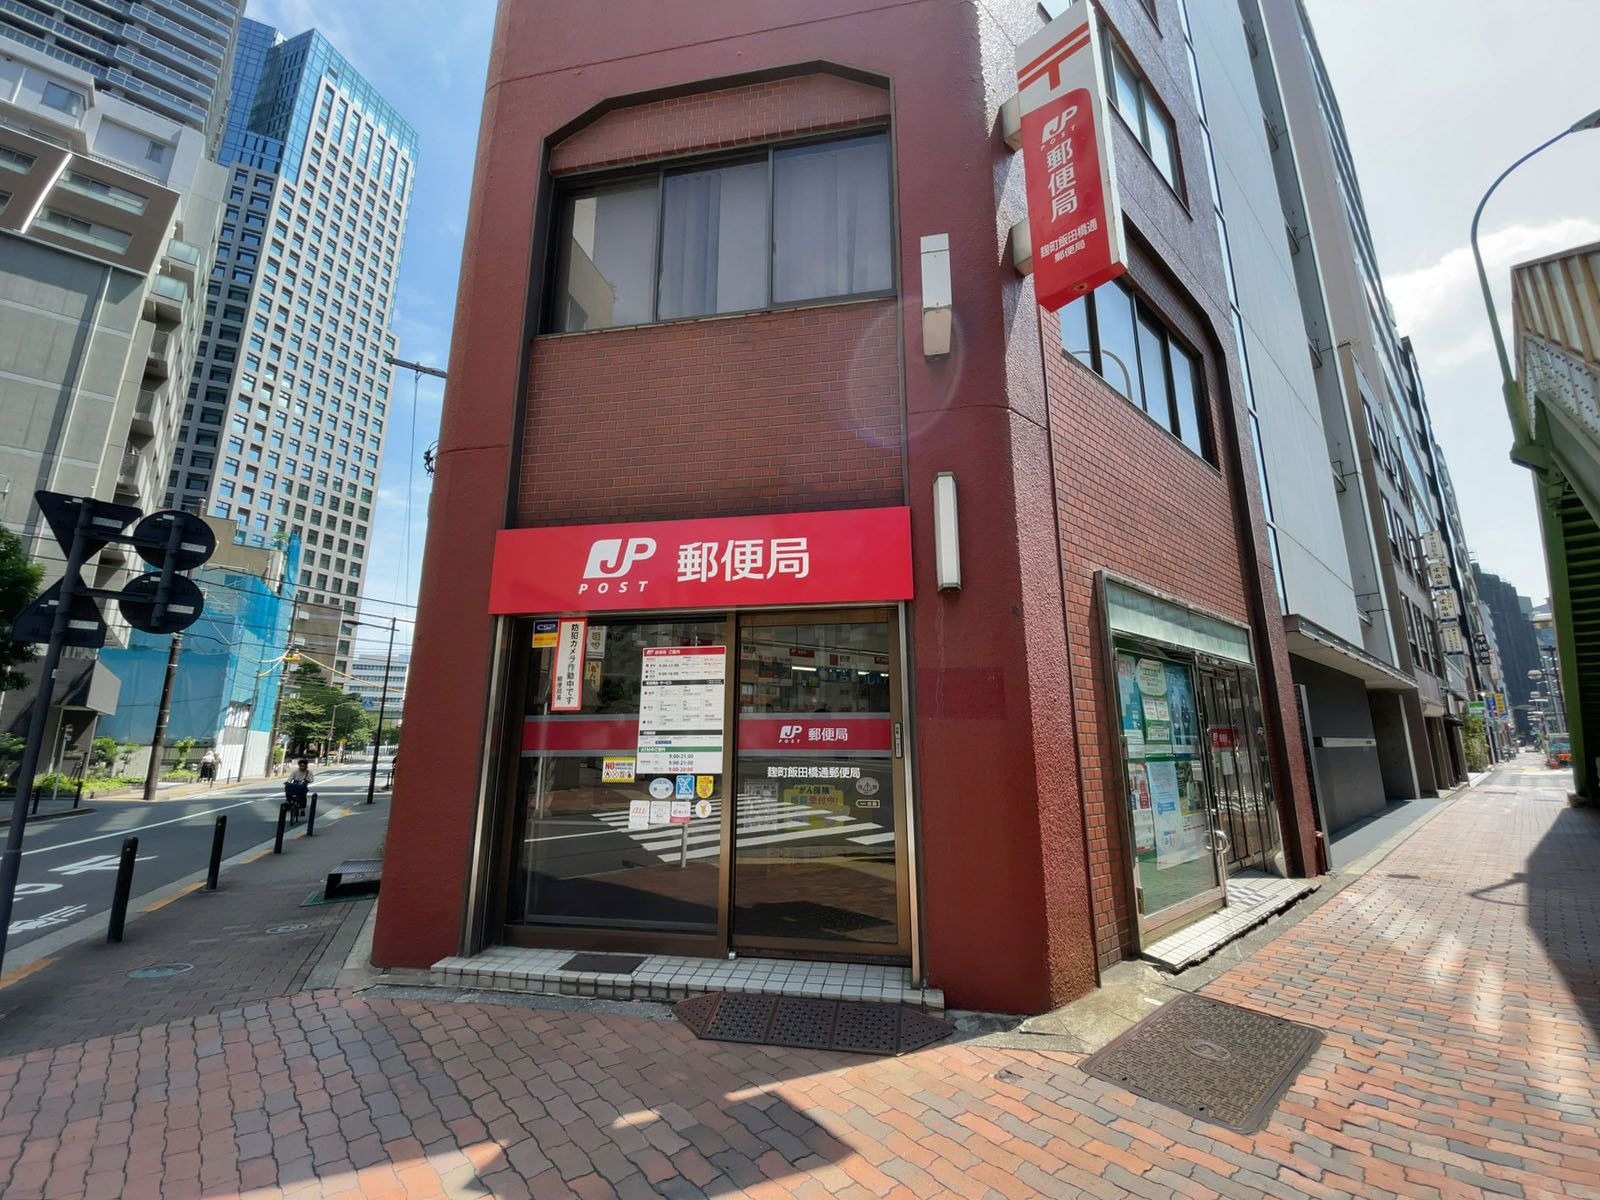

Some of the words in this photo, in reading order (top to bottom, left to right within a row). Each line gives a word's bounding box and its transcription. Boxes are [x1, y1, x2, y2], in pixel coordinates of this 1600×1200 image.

[1040, 124, 1077, 152] POST
[1046, 137, 1078, 223] 郵便局
[1054, 239, 1086, 263] 郵便局
[676, 537, 810, 583] 郵便局
[578, 581, 649, 595] POST
[565, 623, 580, 705] 防犯カメラ作動中です
[808, 728, 848, 742] 郵便局
